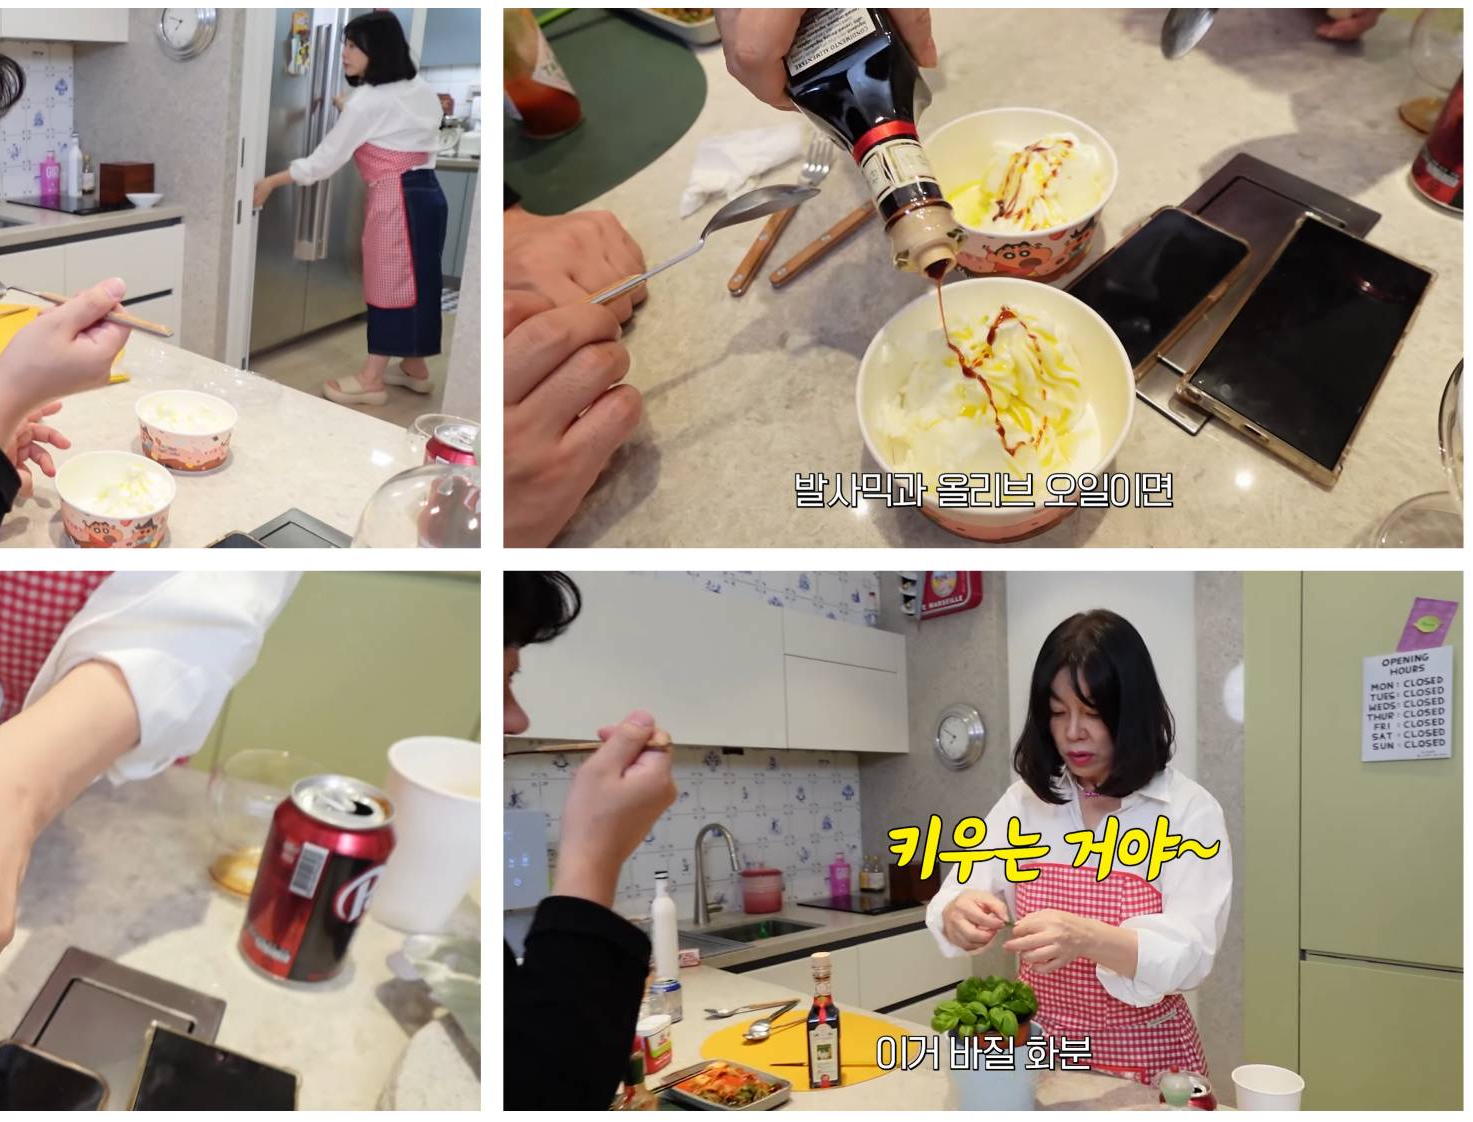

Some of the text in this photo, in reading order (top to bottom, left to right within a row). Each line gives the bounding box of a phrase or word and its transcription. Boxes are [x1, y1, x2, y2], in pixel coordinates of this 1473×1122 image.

[928, 595, 964, 609] MARSEILLE
[1382, 653, 1429, 667] OPENING
[1390, 664, 1425, 675] HOURS
[1403, 676, 1444, 687] CLOSED
[1403, 687, 1445, 697] CLOSED
[1403, 697, 1445, 708] CLOSED
[1403, 707, 1445, 718] CLOSED
[1403, 718, 1445, 728] CLOSED
[1403, 728, 1446, 739] CLOSED
[1404, 739, 1446, 749] CLOSED
